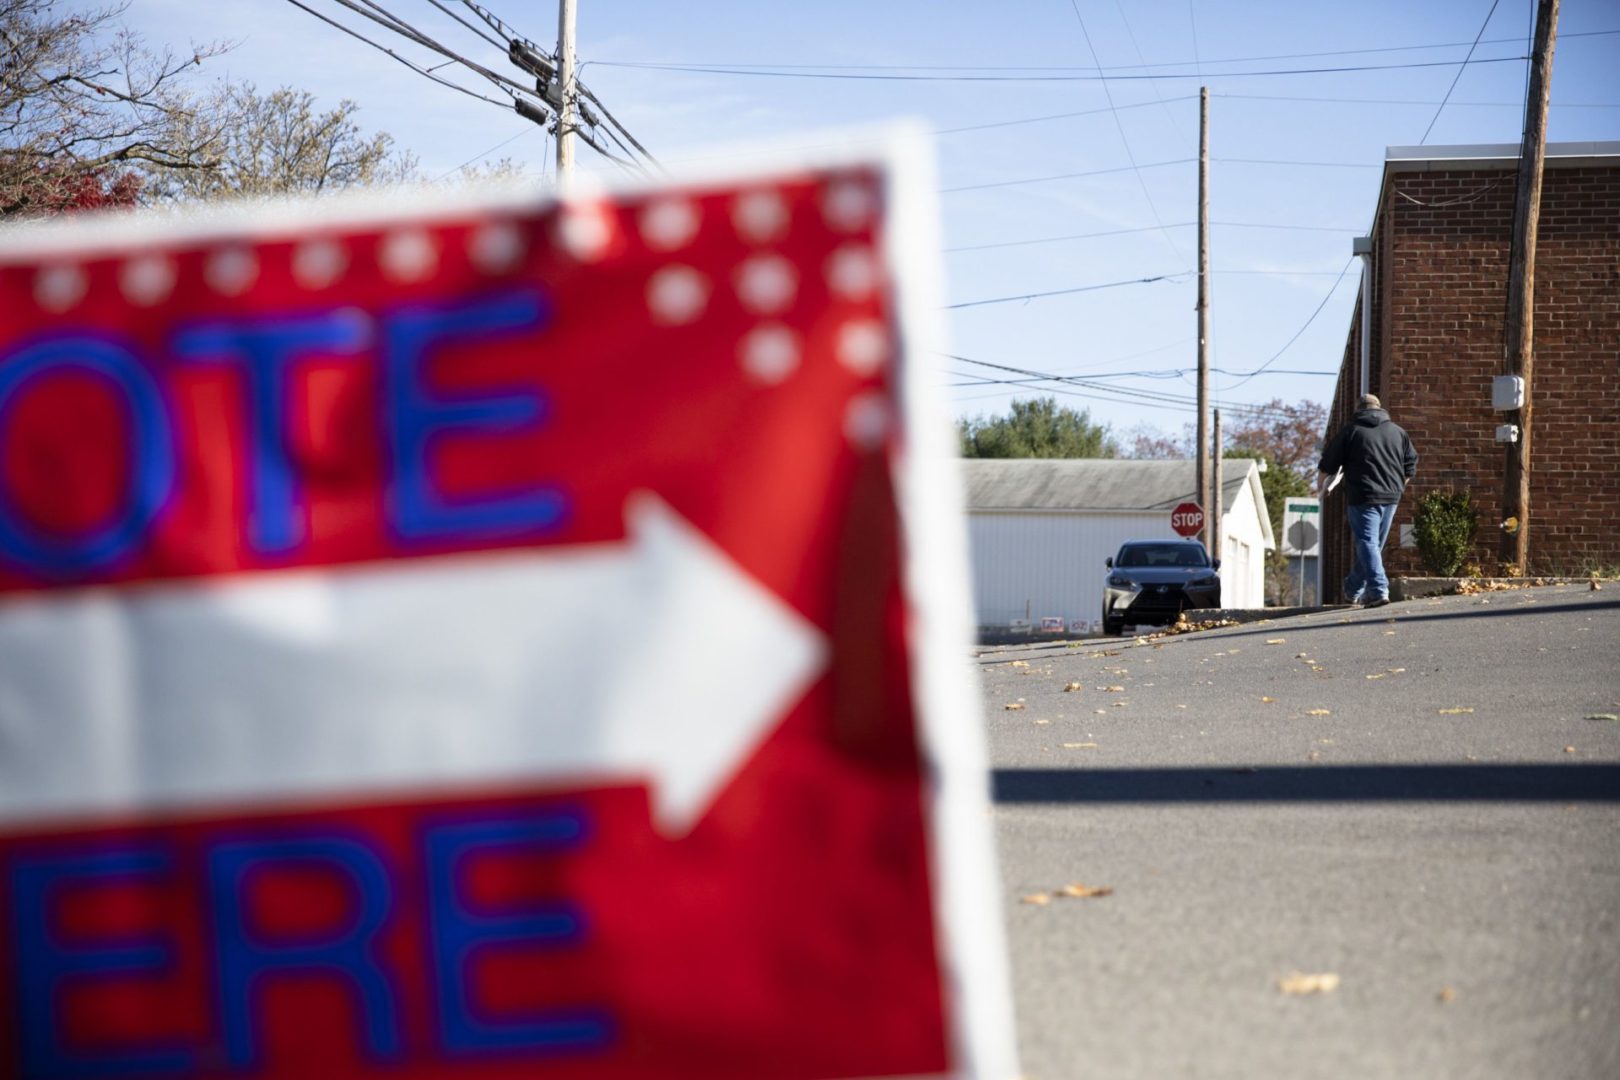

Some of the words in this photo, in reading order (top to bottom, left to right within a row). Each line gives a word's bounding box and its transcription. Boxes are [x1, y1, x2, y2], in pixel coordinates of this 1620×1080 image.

[0, 292, 563, 575] OTE
[1172, 512, 1203, 527] STOP
[7, 811, 609, 1080] ERE
